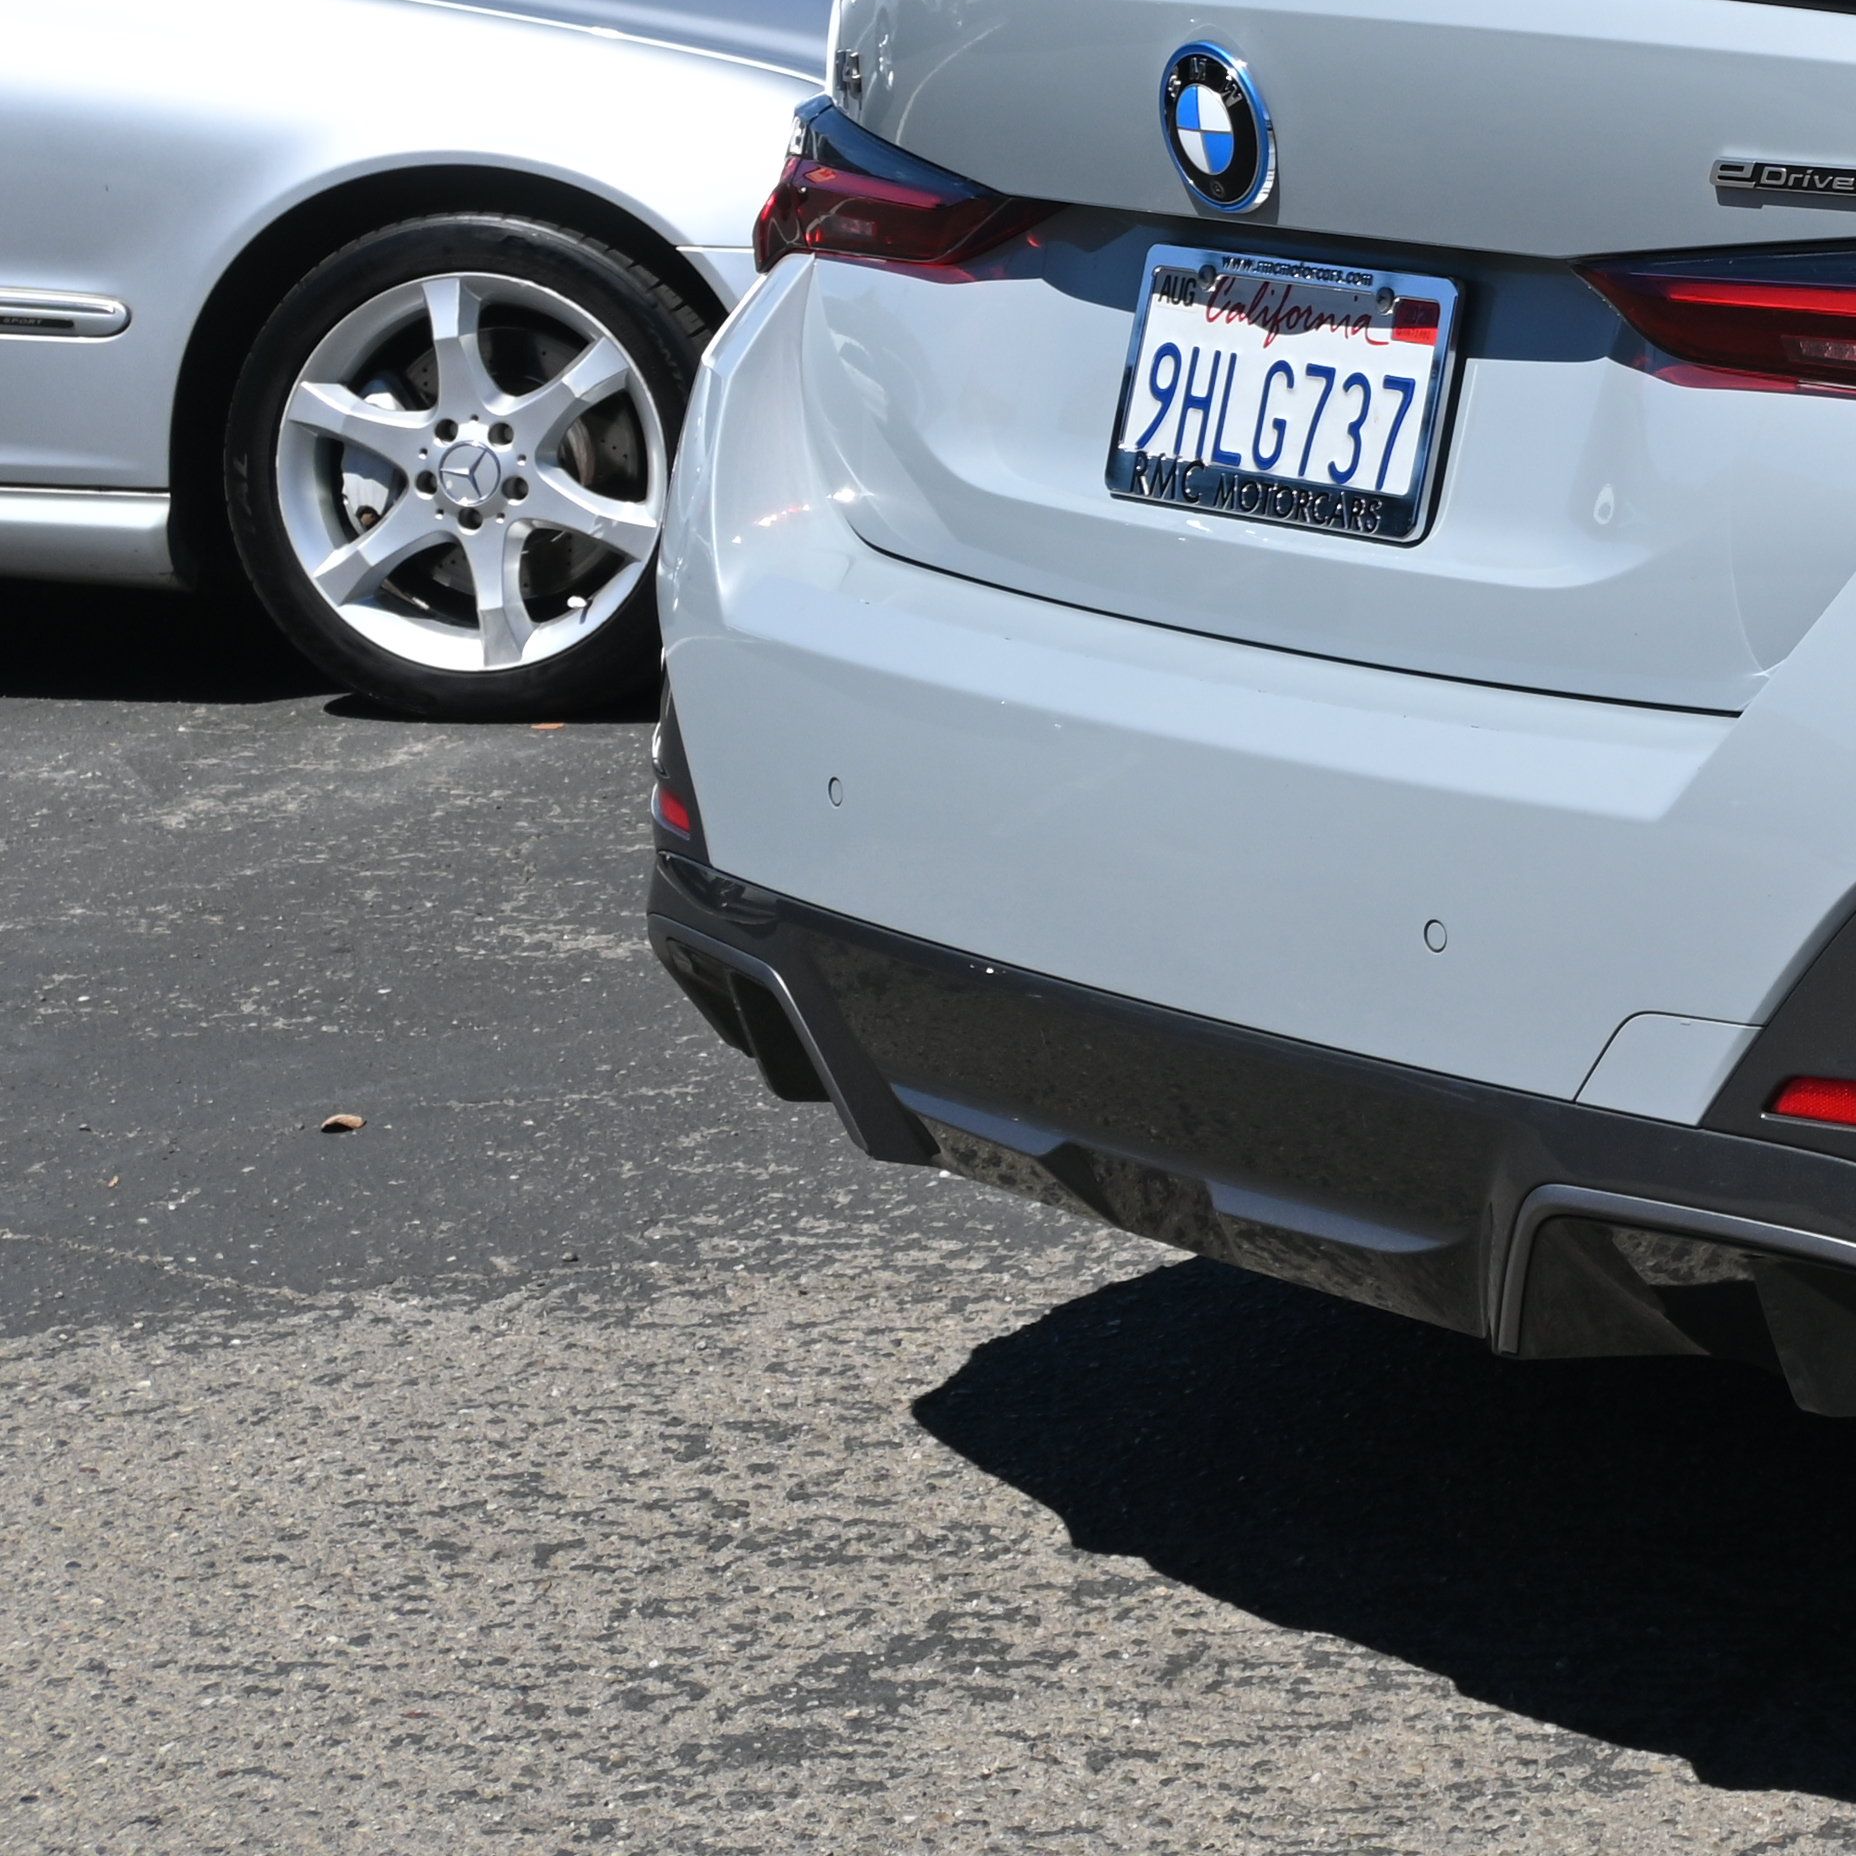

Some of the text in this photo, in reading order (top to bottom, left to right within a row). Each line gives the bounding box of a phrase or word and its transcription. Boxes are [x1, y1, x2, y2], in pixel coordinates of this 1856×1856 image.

[1157, 274, 1197, 308] AUG
[1221, 256, 1374, 286] www.rmcmotorcars.com
[1205, 275, 1391, 349] California
[1135, 341, 1416, 491] 9HLG737
[1130, 450, 1384, 535] RMC MOTORCARS
